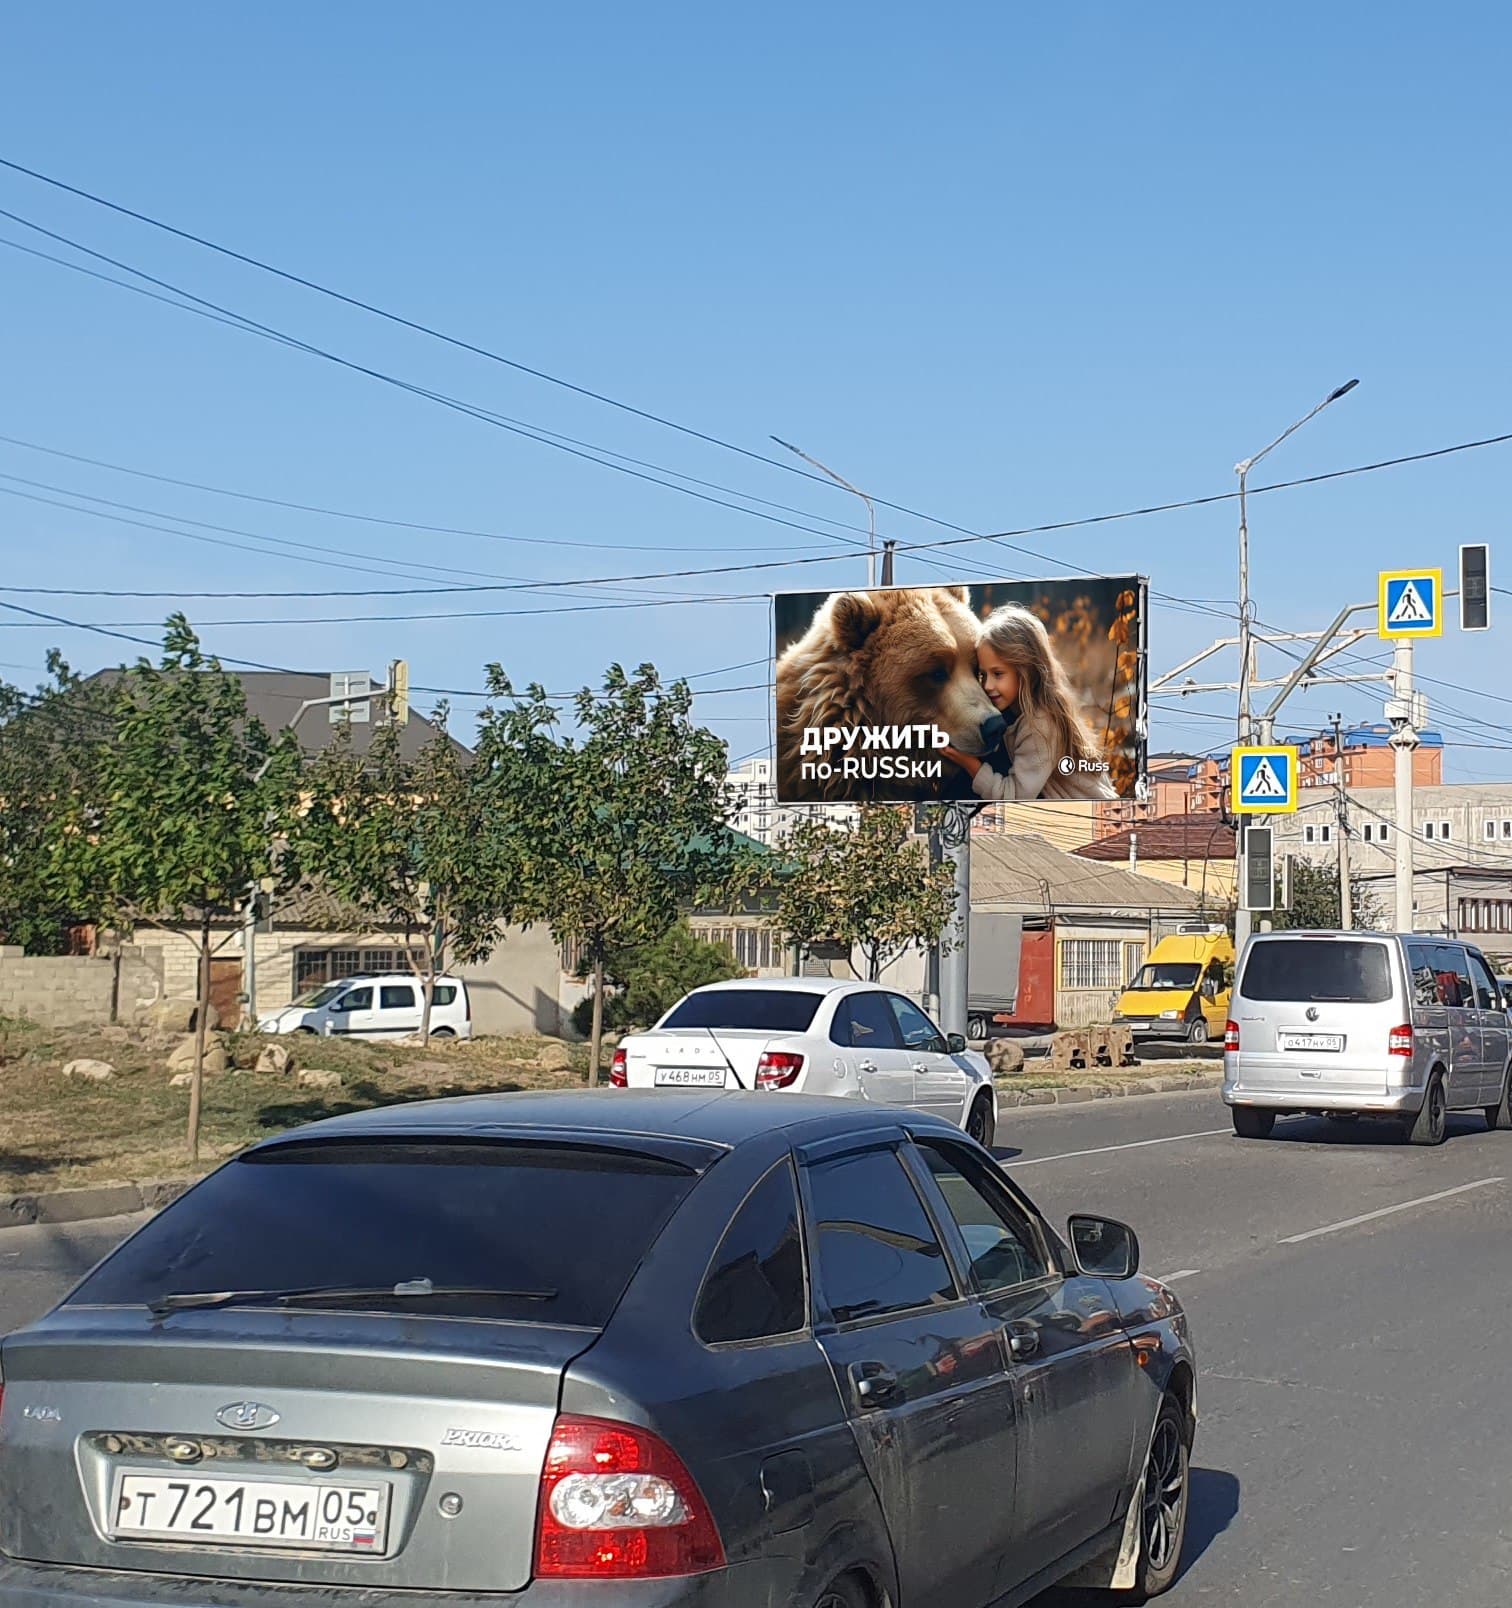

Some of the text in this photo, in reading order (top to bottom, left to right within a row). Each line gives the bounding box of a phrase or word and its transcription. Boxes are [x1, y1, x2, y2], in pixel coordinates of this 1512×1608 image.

[800, 724, 950, 756] ДРУЖИТЬ
[801, 755, 942, 780] по-RUSSки
[1078, 759, 1110, 772] Russ
[23, 1405, 62, 1421] LADA
[441, 1428, 522, 1451] PRIORA
[323, 1490, 367, 1526] 05
[318, 1526, 351, 1541] RUS
